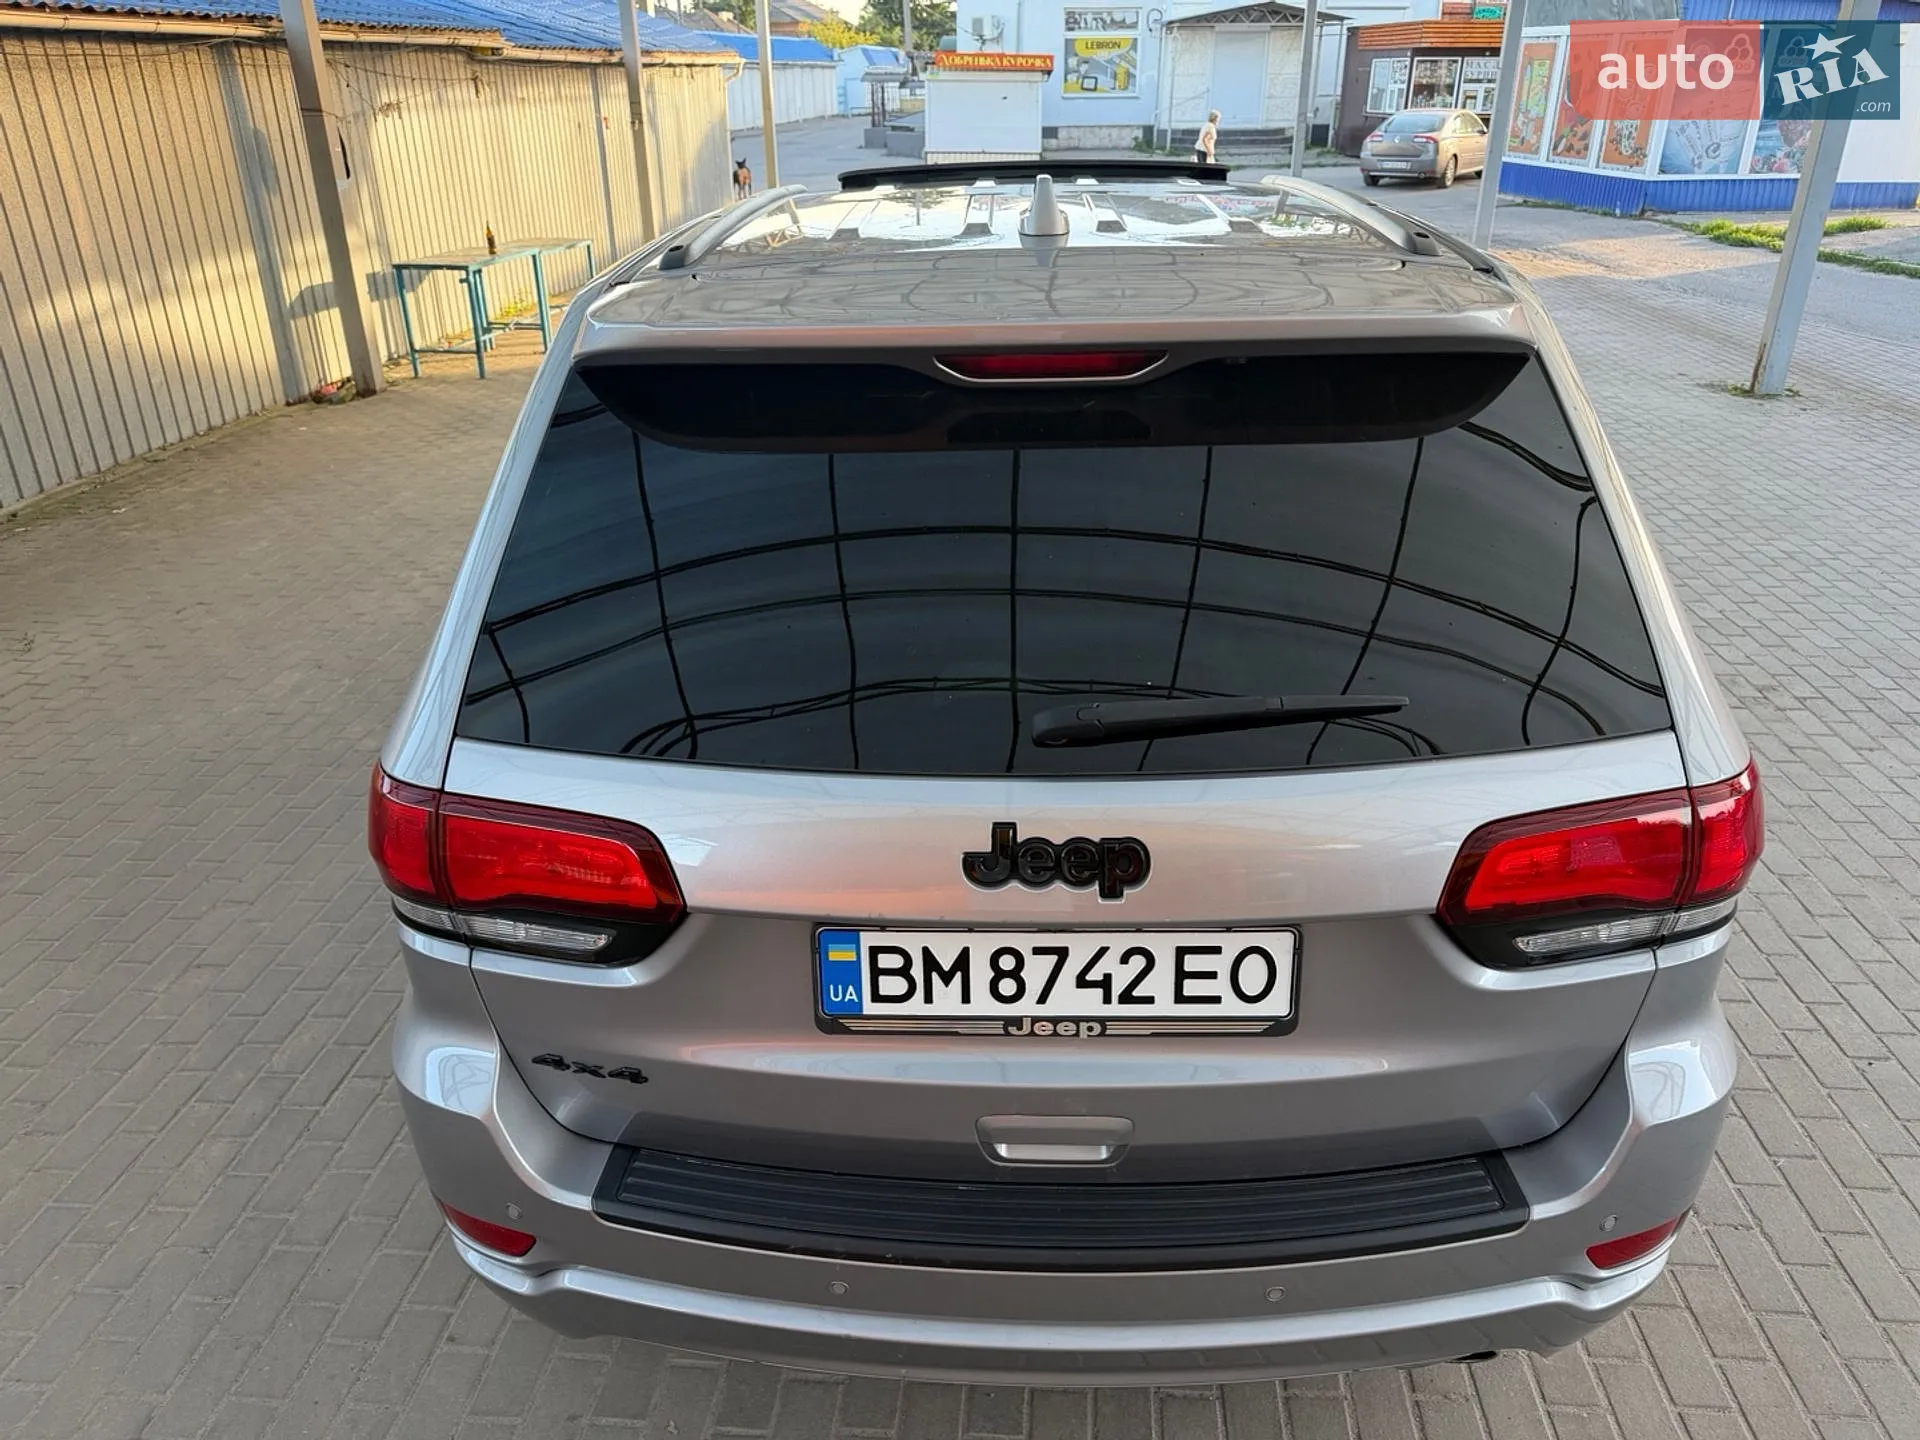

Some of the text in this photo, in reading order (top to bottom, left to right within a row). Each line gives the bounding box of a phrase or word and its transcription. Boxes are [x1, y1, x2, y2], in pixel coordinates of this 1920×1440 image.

[1085, 41, 1121, 50] LEBRON
[962, 822, 1151, 900] Jeep
[868, 945, 1278, 1005] BM 8742 EO
[830, 984, 859, 1003] UA
[1008, 1017, 1101, 1038] Jeep
[531, 1053, 649, 1085] 4x4
